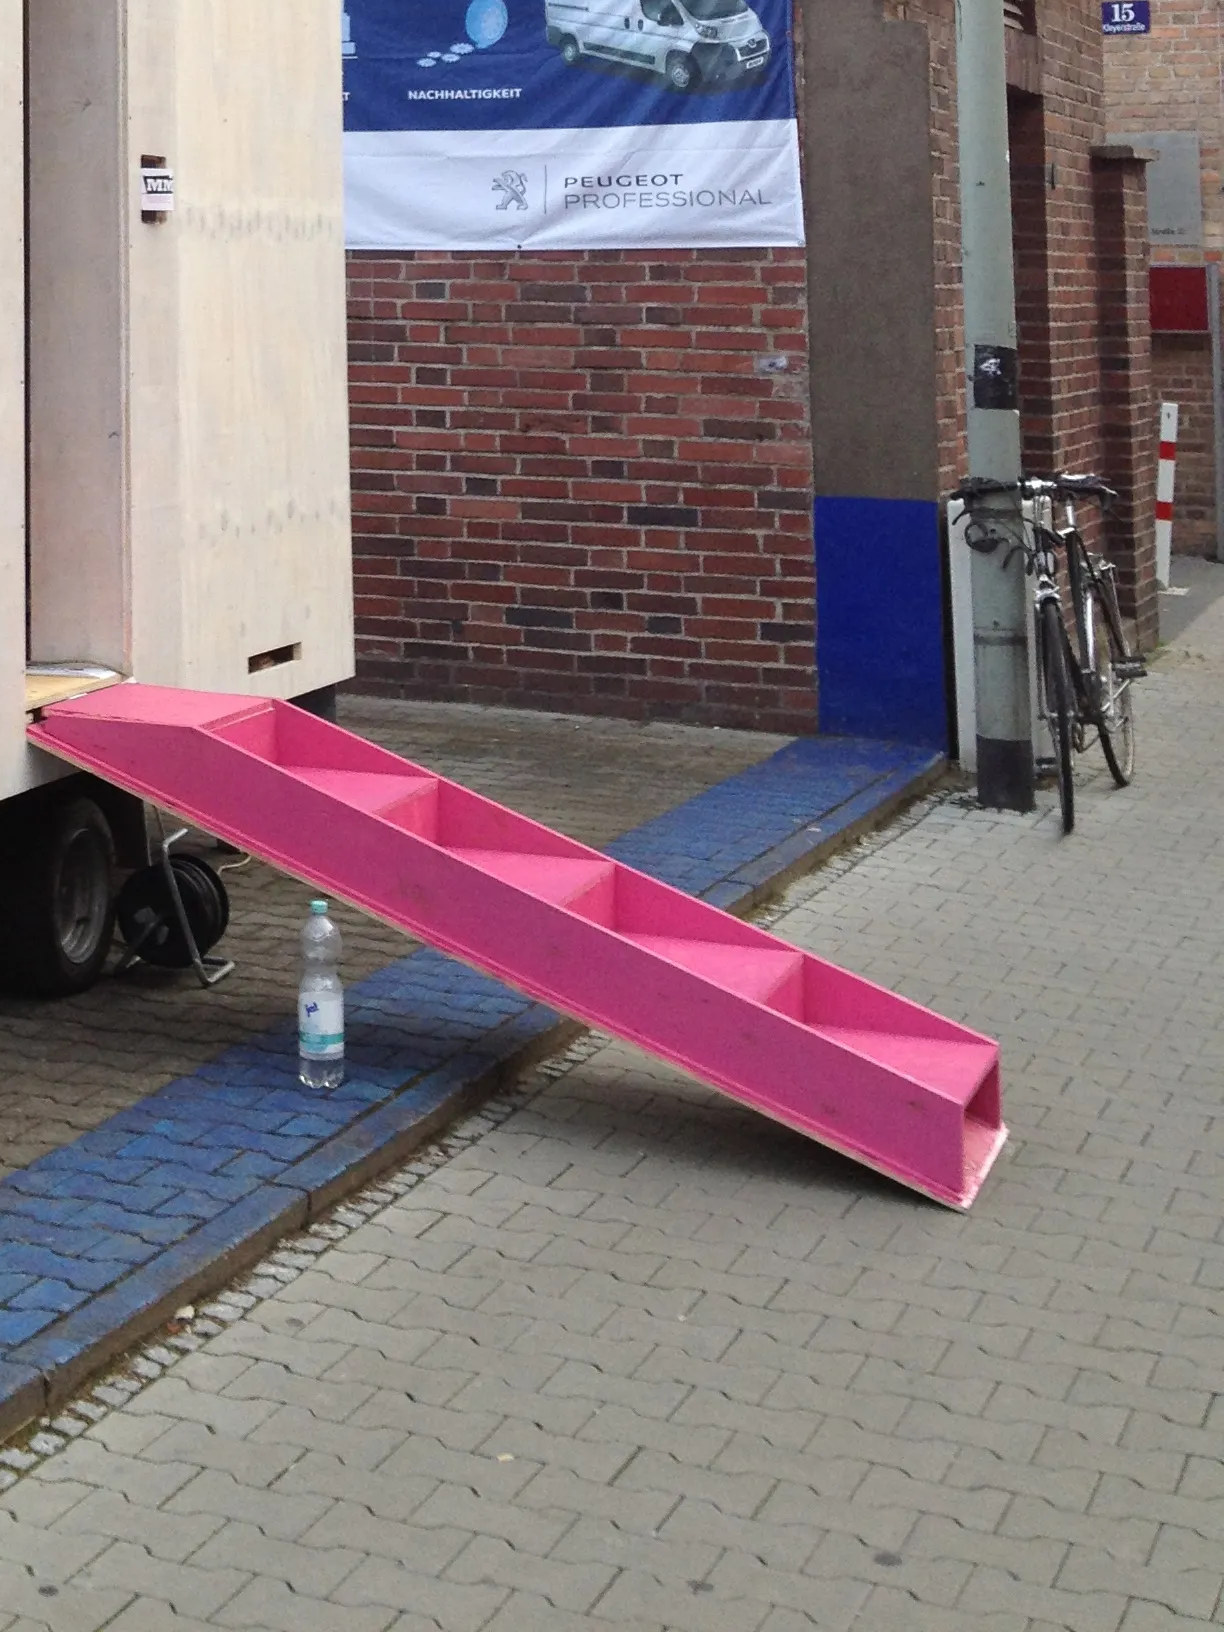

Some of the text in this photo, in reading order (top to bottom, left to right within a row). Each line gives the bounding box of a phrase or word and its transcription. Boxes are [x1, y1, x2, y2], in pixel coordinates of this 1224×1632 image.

[1111, 3, 1135, 22] 15
[408, 88, 522, 100] NACHHALTIGKEIT
[564, 173, 684, 188] PEUGEOT
[564, 189, 773, 210] PROFESSIONAL
